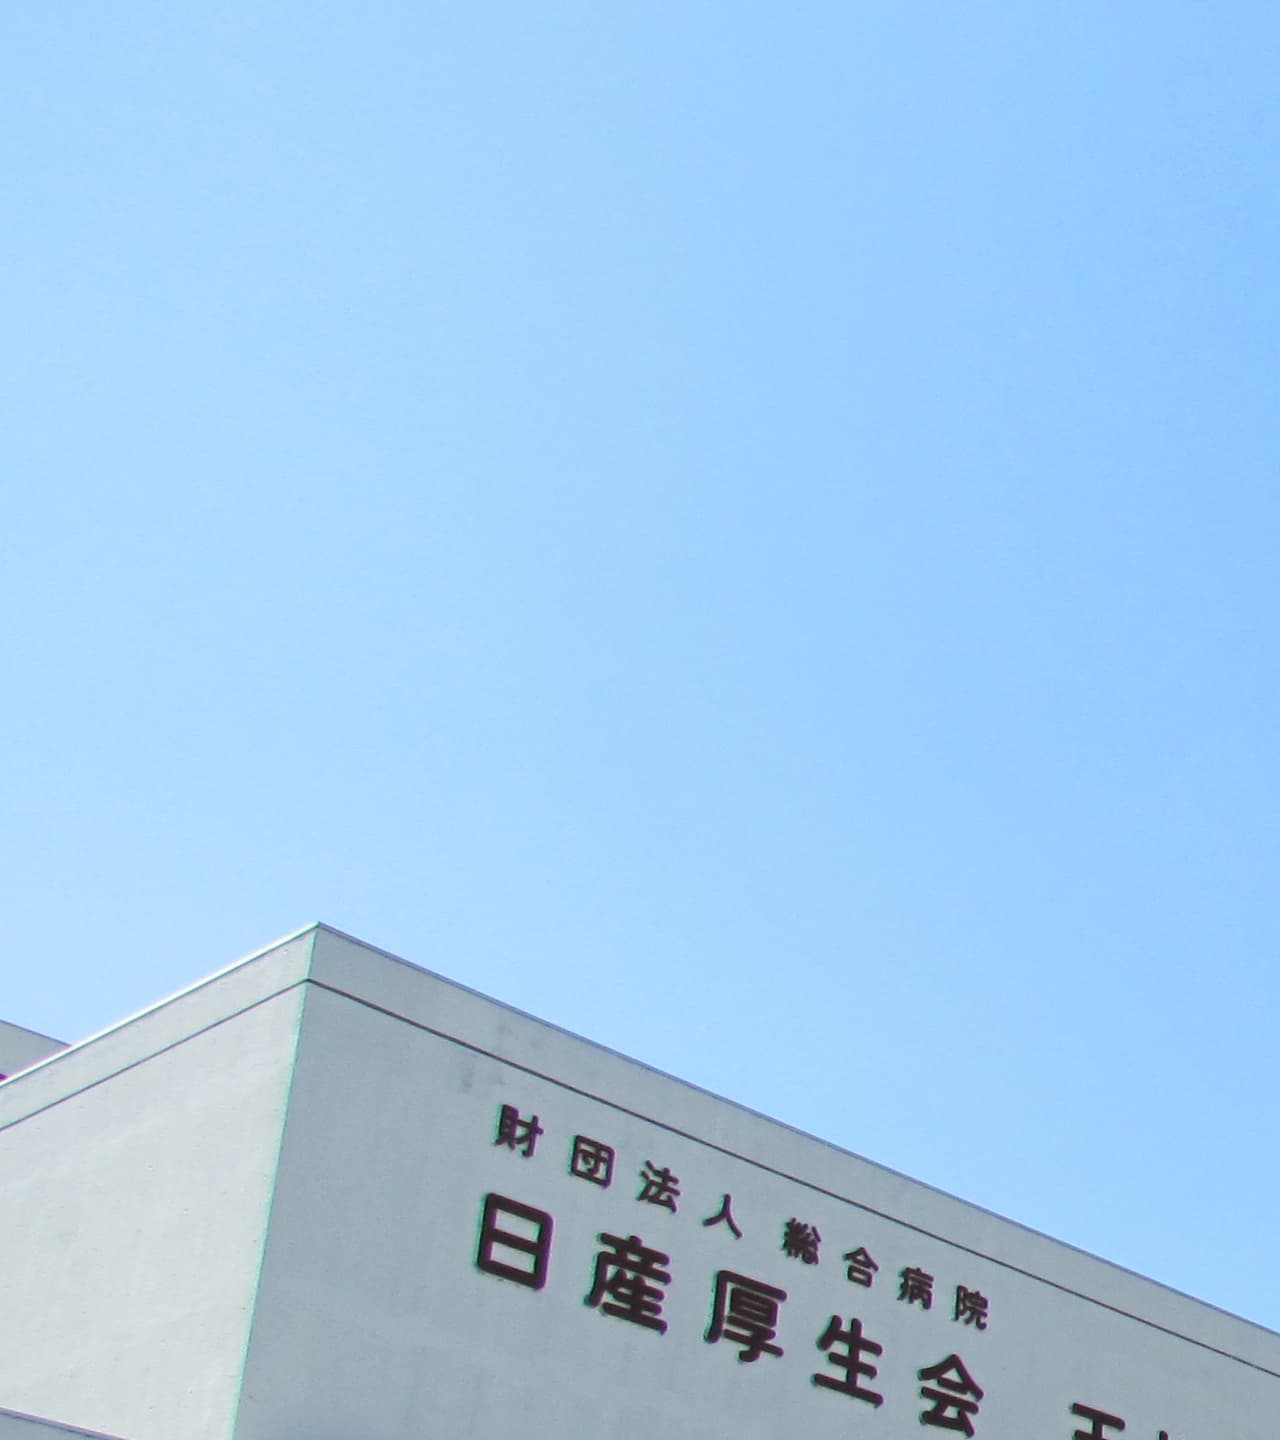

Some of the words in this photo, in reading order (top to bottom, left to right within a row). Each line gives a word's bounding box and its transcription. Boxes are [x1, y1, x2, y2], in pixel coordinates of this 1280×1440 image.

[474, 1191, 985, 1440] 日産厚生会
